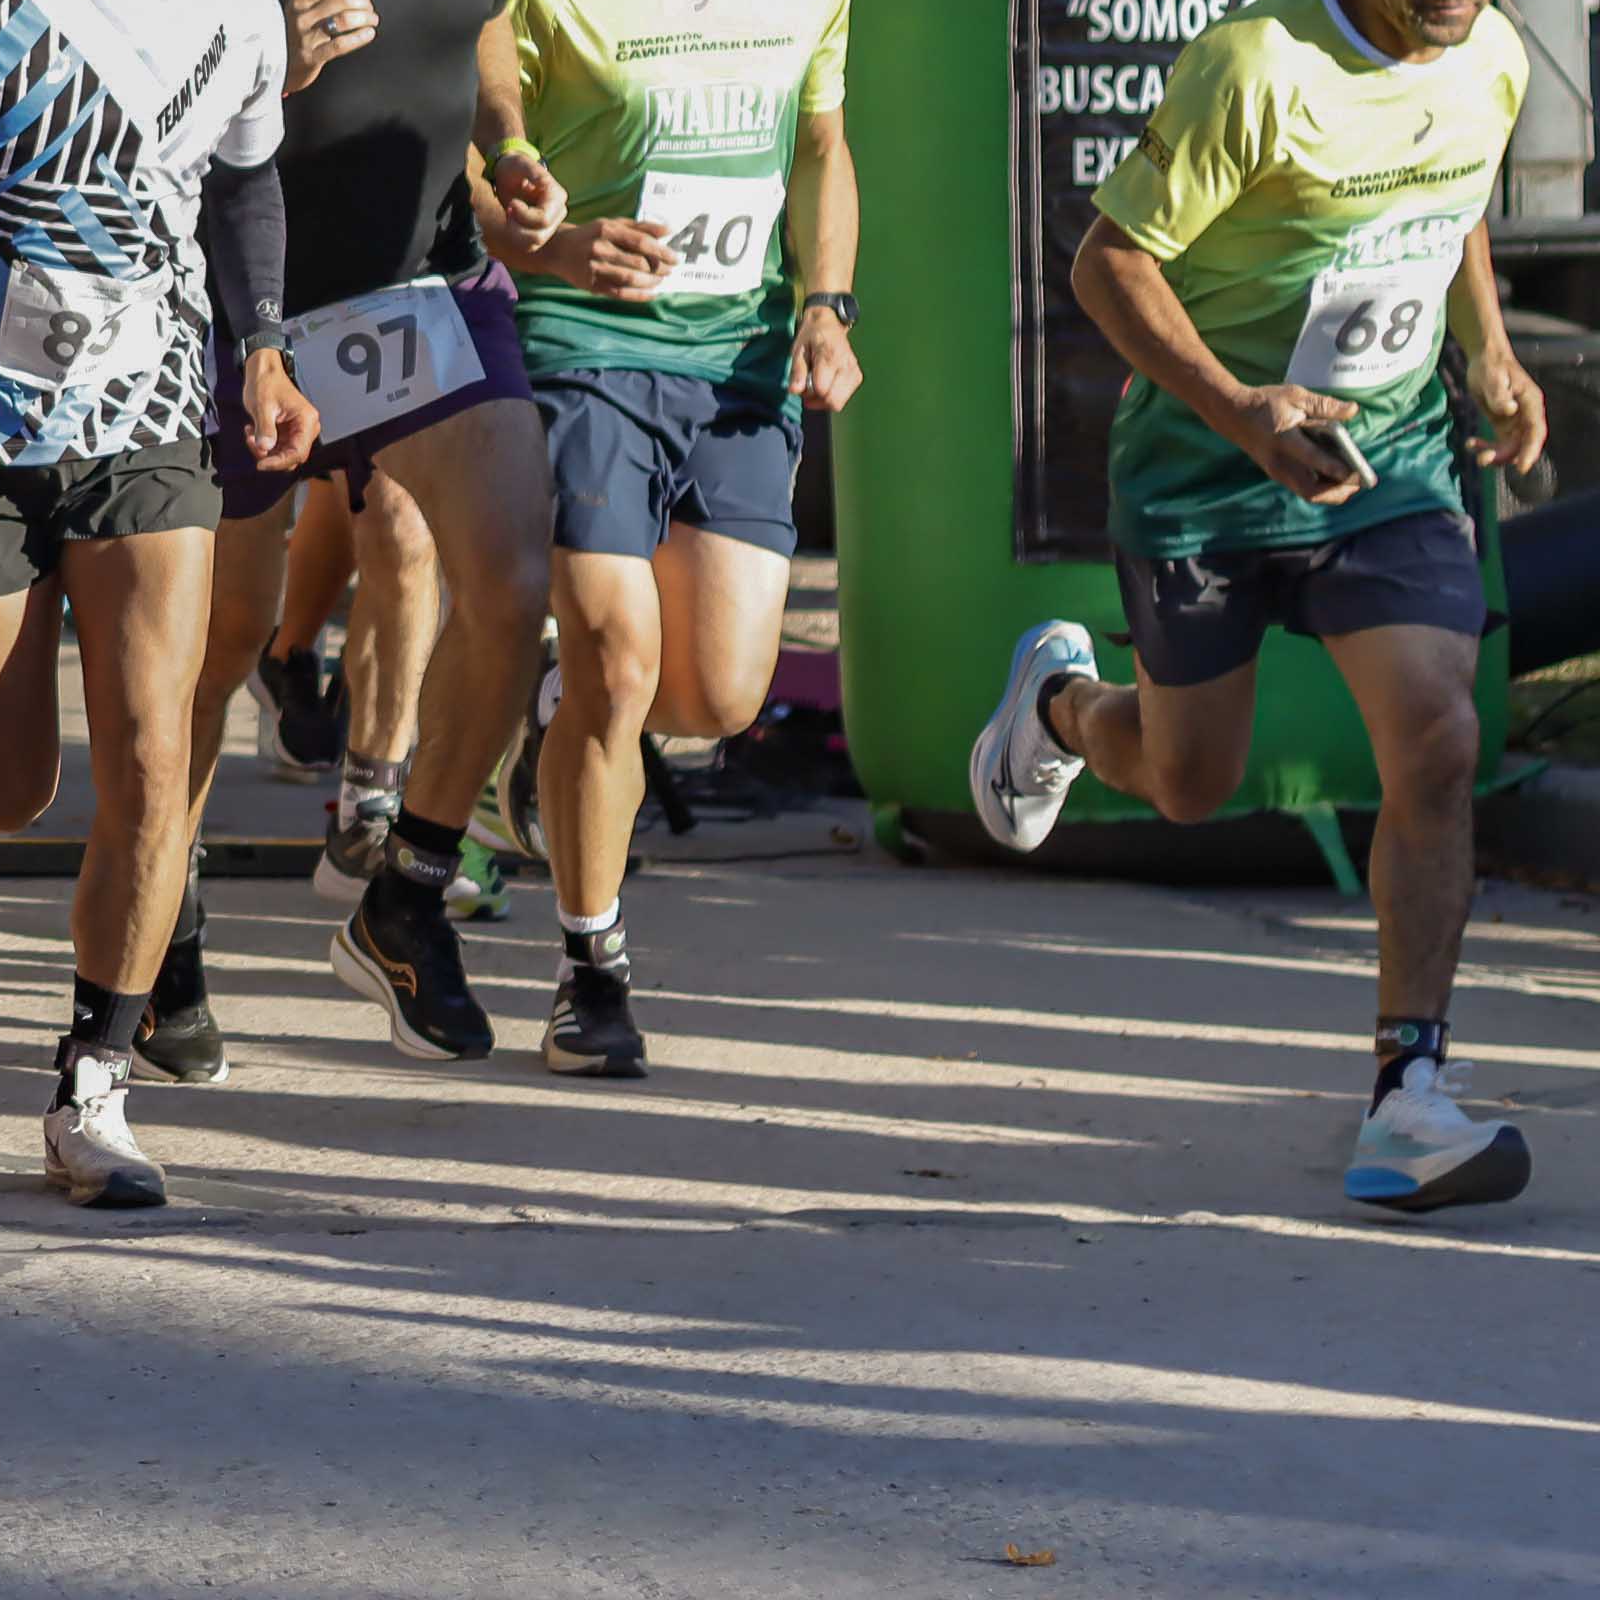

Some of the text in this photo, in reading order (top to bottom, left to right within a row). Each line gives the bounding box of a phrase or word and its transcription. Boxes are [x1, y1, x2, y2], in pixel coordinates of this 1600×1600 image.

[156, 78, 192, 144] TEAM
[653, 83, 777, 137] MAIRA
[1038, 65, 1174, 115] BUSCA
[667, 213, 754, 267] 40
[336, 314, 417, 394] 97
[1334, 299, 1424, 357] 68
